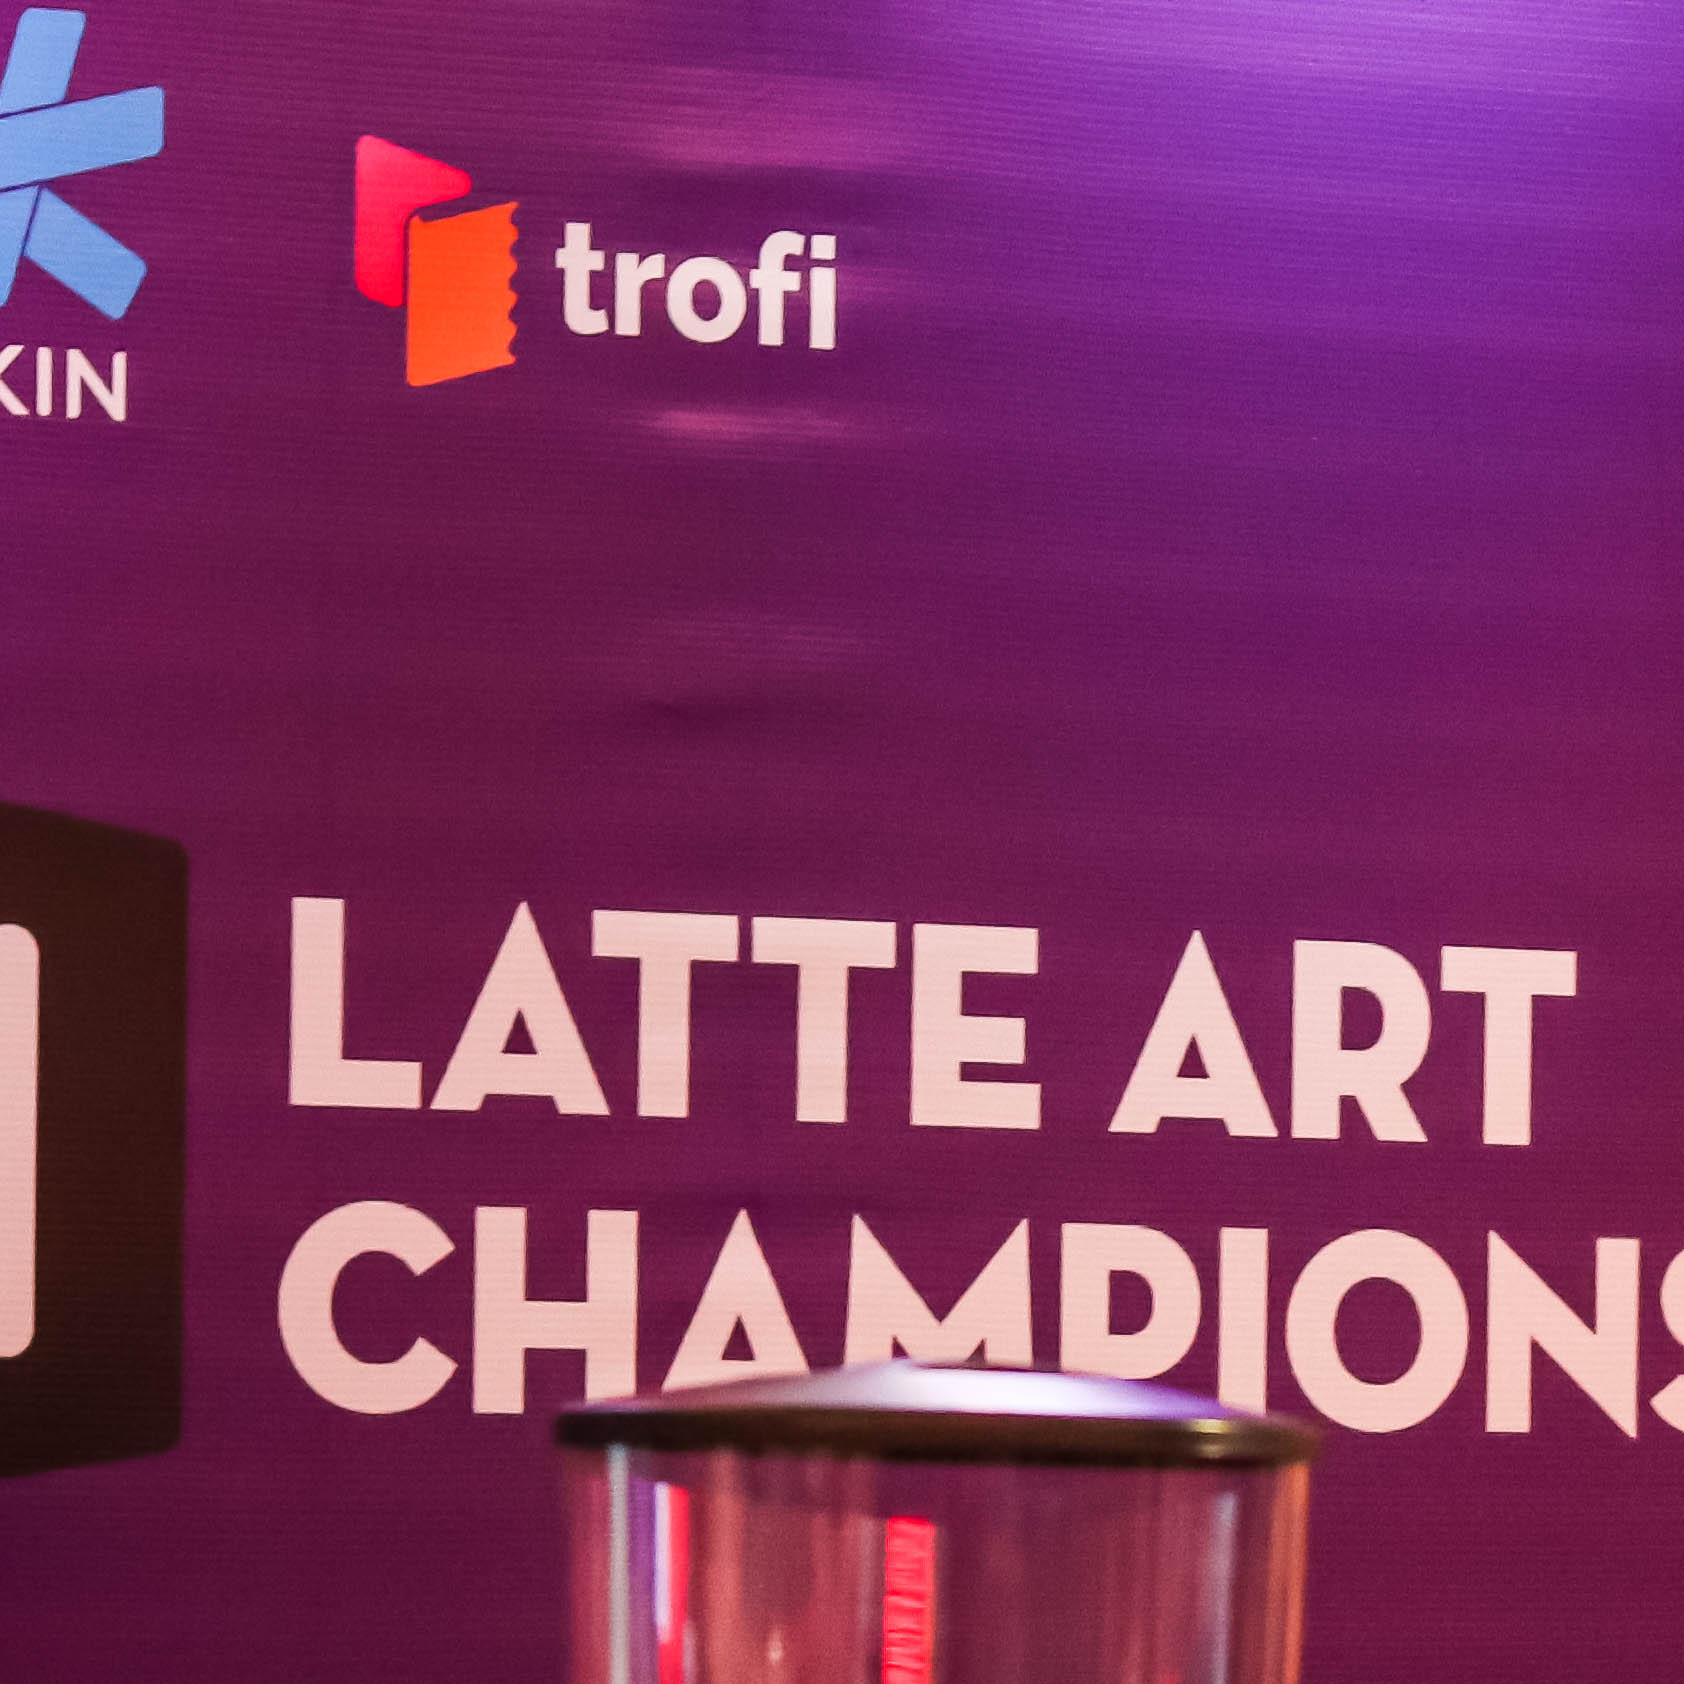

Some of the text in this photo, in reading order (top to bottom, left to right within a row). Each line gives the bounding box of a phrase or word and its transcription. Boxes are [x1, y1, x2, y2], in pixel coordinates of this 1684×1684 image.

[556, 222, 837, 350] trofi
[289, 896, 1578, 1147] LATTE ART
